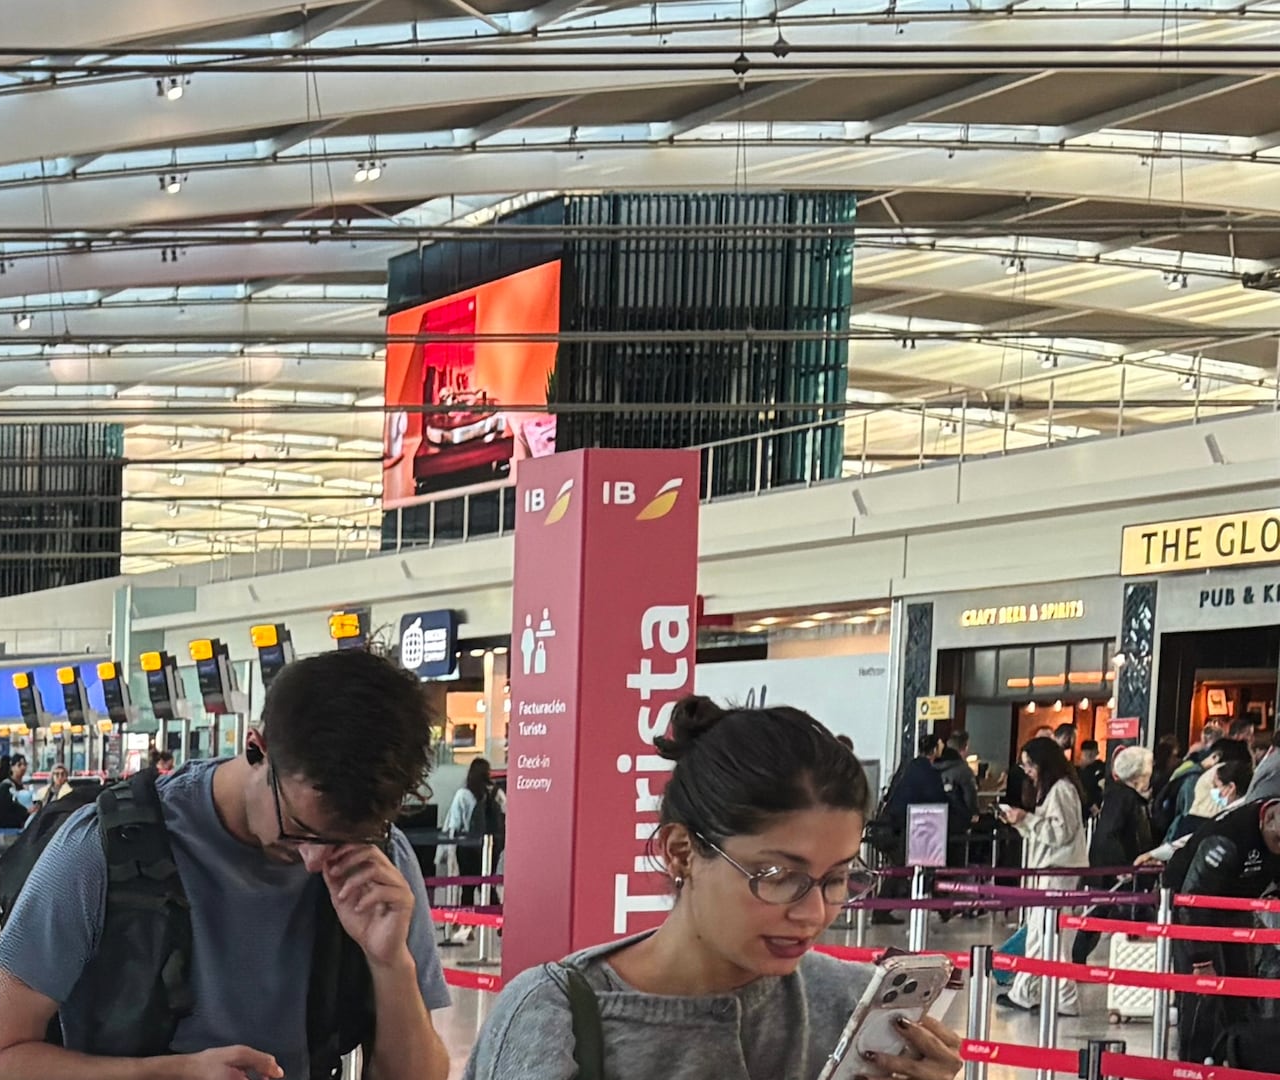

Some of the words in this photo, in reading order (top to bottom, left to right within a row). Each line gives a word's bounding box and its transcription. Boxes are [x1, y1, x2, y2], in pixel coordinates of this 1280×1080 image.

[525, 488, 545, 512] IB
[603, 481, 636, 504] IB
[1141, 526, 1202, 565] THE
[1216, 517, 1280, 557] GLO
[1199, 589, 1235, 608] PUB
[1243, 586, 1254, 604] &
[519, 699, 567, 716] Facturación
[516, 775, 553, 793] Economy
[1172, 1068, 1203, 1080] IBERIA
